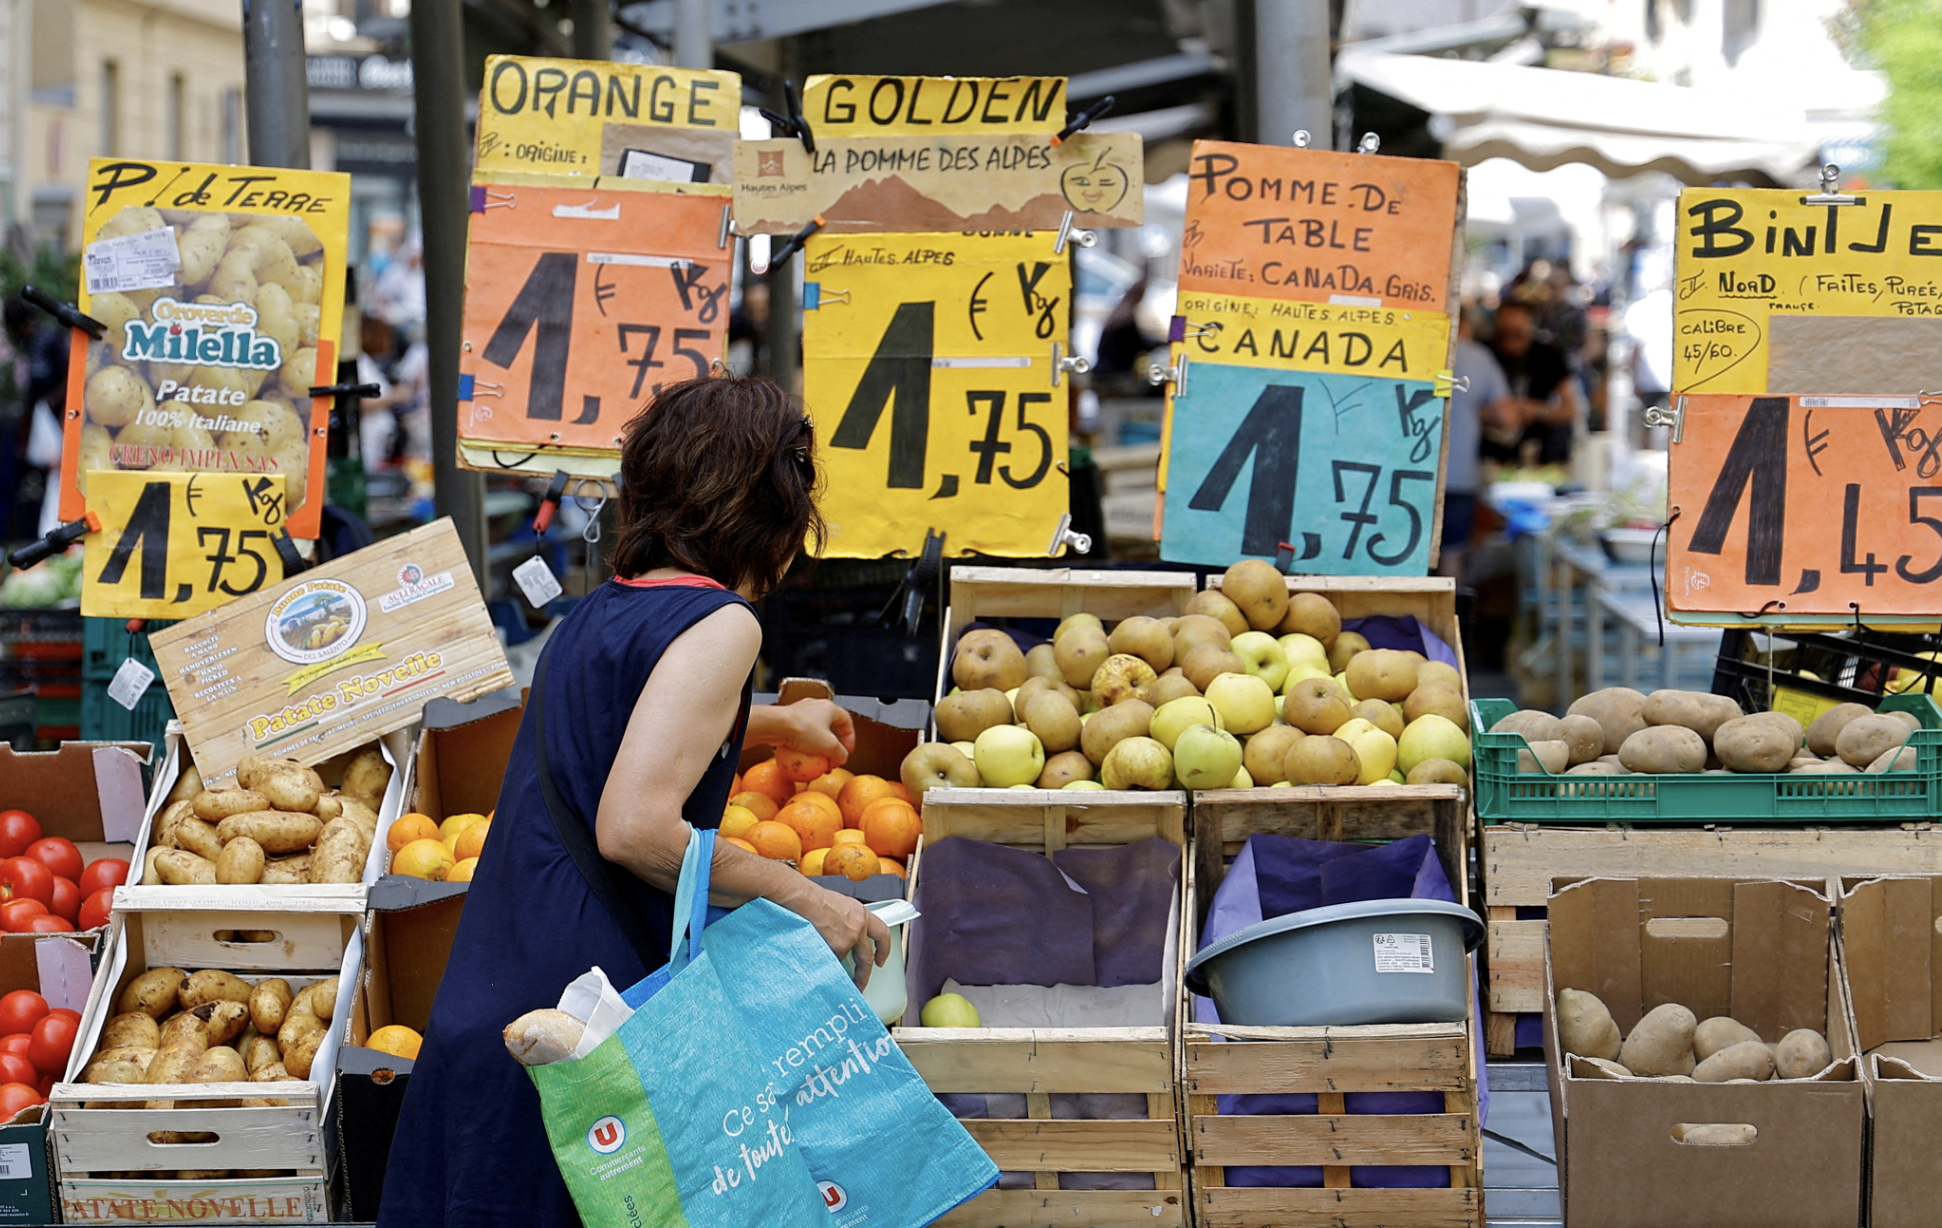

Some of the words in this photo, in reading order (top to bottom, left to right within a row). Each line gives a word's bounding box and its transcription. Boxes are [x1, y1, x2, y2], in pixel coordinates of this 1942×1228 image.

[491, 61, 719, 126] ORANGE
[824, 78, 1065, 126] GOLDEN
[813, 149, 835, 174] LA
[846, 148, 931, 174] POMME
[939, 146, 980, 172] DES
[986, 145, 1052, 171] ALPES
[220, 176, 333, 213] TERRE
[741, 183, 777, 192] Hautes
[780, 183, 807, 192] Alpes
[1243, 218, 1374, 252] TABLE
[670, 261, 727, 324] Kg
[1017, 262, 1060, 339] Kg
[157, 302, 253, 327] Oroverde
[127, 323, 277, 367] Milella
[482, 252, 711, 425] 1,75
[1197, 322, 1408, 373] CANADA
[156, 380, 246, 406] Patate
[829, 300, 1053, 500] 1,75
[135, 409, 183, 428] 100%
[188, 414, 262, 434] Italiane
[1395, 383, 1441, 464] Kg
[109, 444, 174, 465] CRENO
[180, 448, 239, 470] IMPEX
[244, 451, 279, 472] SAS
[1874, 407, 1942, 479] Kg
[1188, 384, 1434, 566] 1,75
[242, 477, 283, 525] Kg
[1688, 397, 1942, 596] 1,45
[97, 482, 268, 603] 1,75
[272, 586, 305, 617] Buone
[306, 581, 347, 593] Patate
[179, 646, 237, 675] HANDVERLESEN
[183, 635, 220, 653] RACCOLTE
[197, 643, 219, 655] MANO
[303, 651, 317, 660] DEL
[318, 639, 349, 656] SALENTO
[200, 663, 223, 677] HAND
[200, 669, 229, 685] PICKED
[206, 693, 217, 702] LA
[217, 685, 237, 698] MAIN
[248, 694, 337, 740] Patate
[338, 651, 443, 703] Novelle
[273, 744, 299, 757] POMMES
[441, 681, 456, 689] NEW
[457, 668, 488, 685] POTATOES
[723, 1106, 754, 1137] Ce
[772, 998, 868, 1078] rempli
[594, 1122, 618, 1147] U
[590, 1145, 646, 1176] Commerçants
[600, 1156, 643, 1181] autrement
[712, 1165, 741, 1195] de
[161, 1197, 303, 1219] NOVELLE
